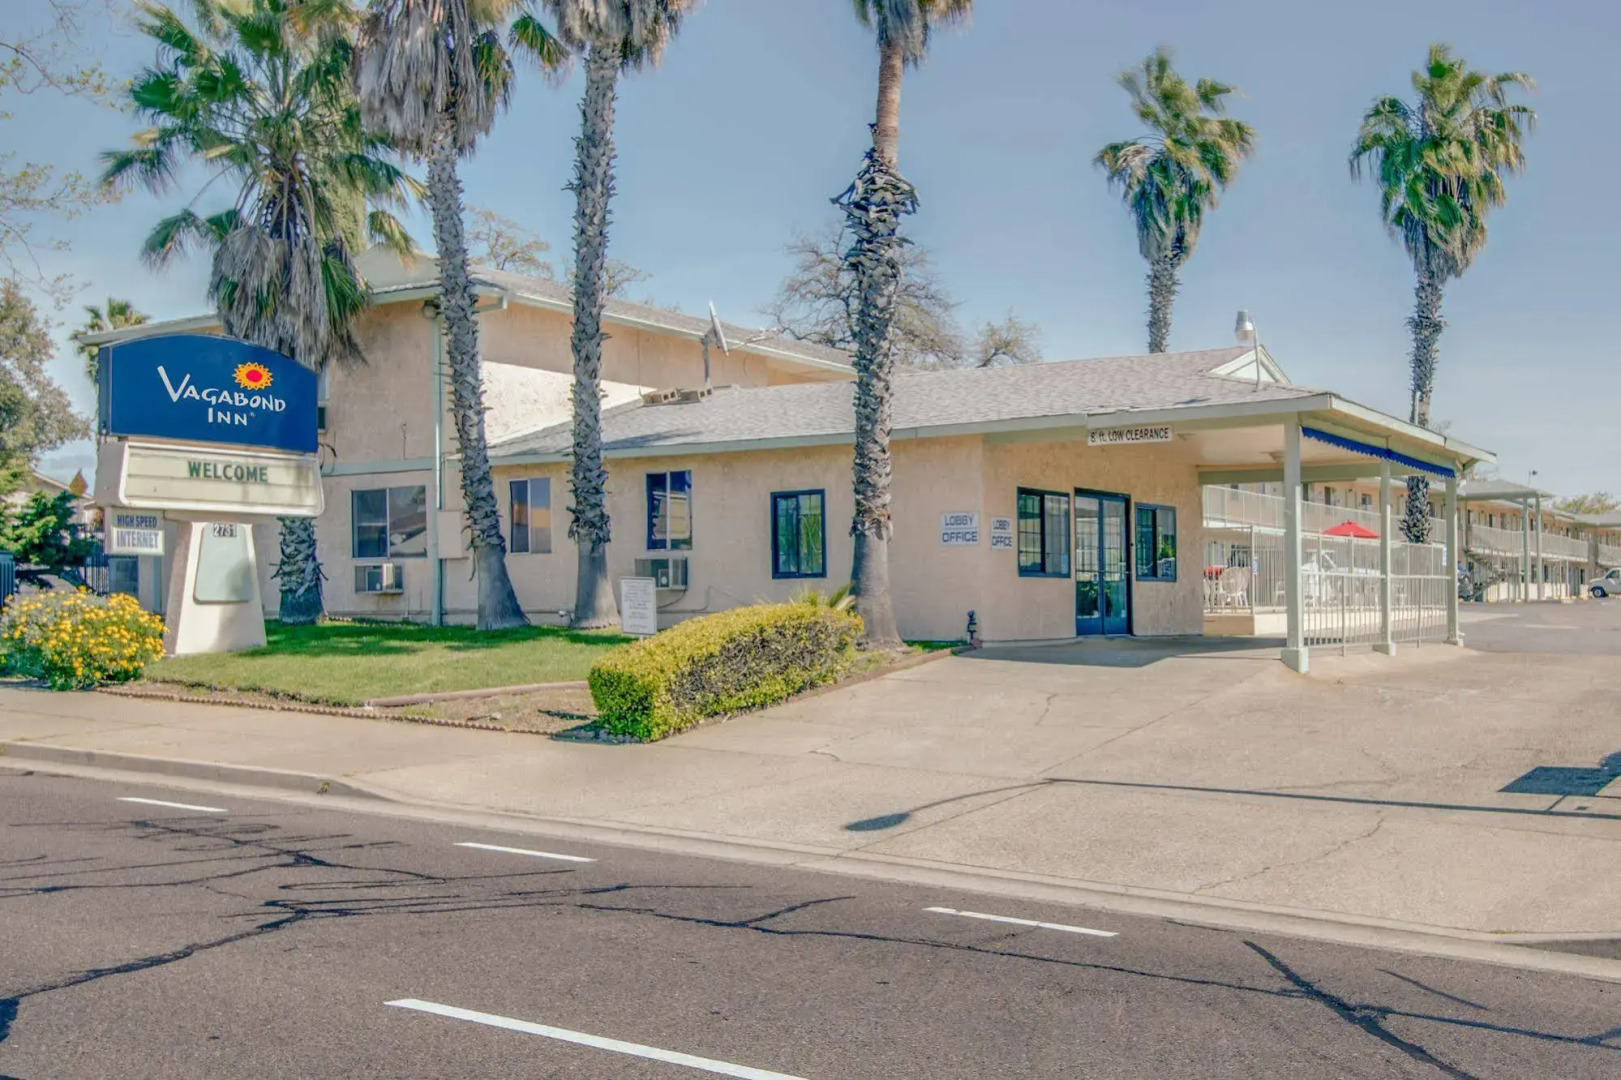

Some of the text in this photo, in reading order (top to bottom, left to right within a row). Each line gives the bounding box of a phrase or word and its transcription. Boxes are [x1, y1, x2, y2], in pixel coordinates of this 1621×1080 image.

[157, 365, 286, 412] VAGABOND
[208, 407, 248, 426] INN
[1108, 430, 1124, 442] LOW
[1125, 427, 1169, 441] CLEARANCE
[188, 461, 268, 482] WELCOME
[117, 514, 158, 528] HIGH SPEED
[944, 514, 974, 527] LOBBY
[993, 519, 1010, 531] LOBBY
[213, 522, 238, 537] 2731
[942, 531, 978, 543] OFFICE
[116, 530, 159, 549] INTERNET
[992, 535, 1012, 547] OFFICE
